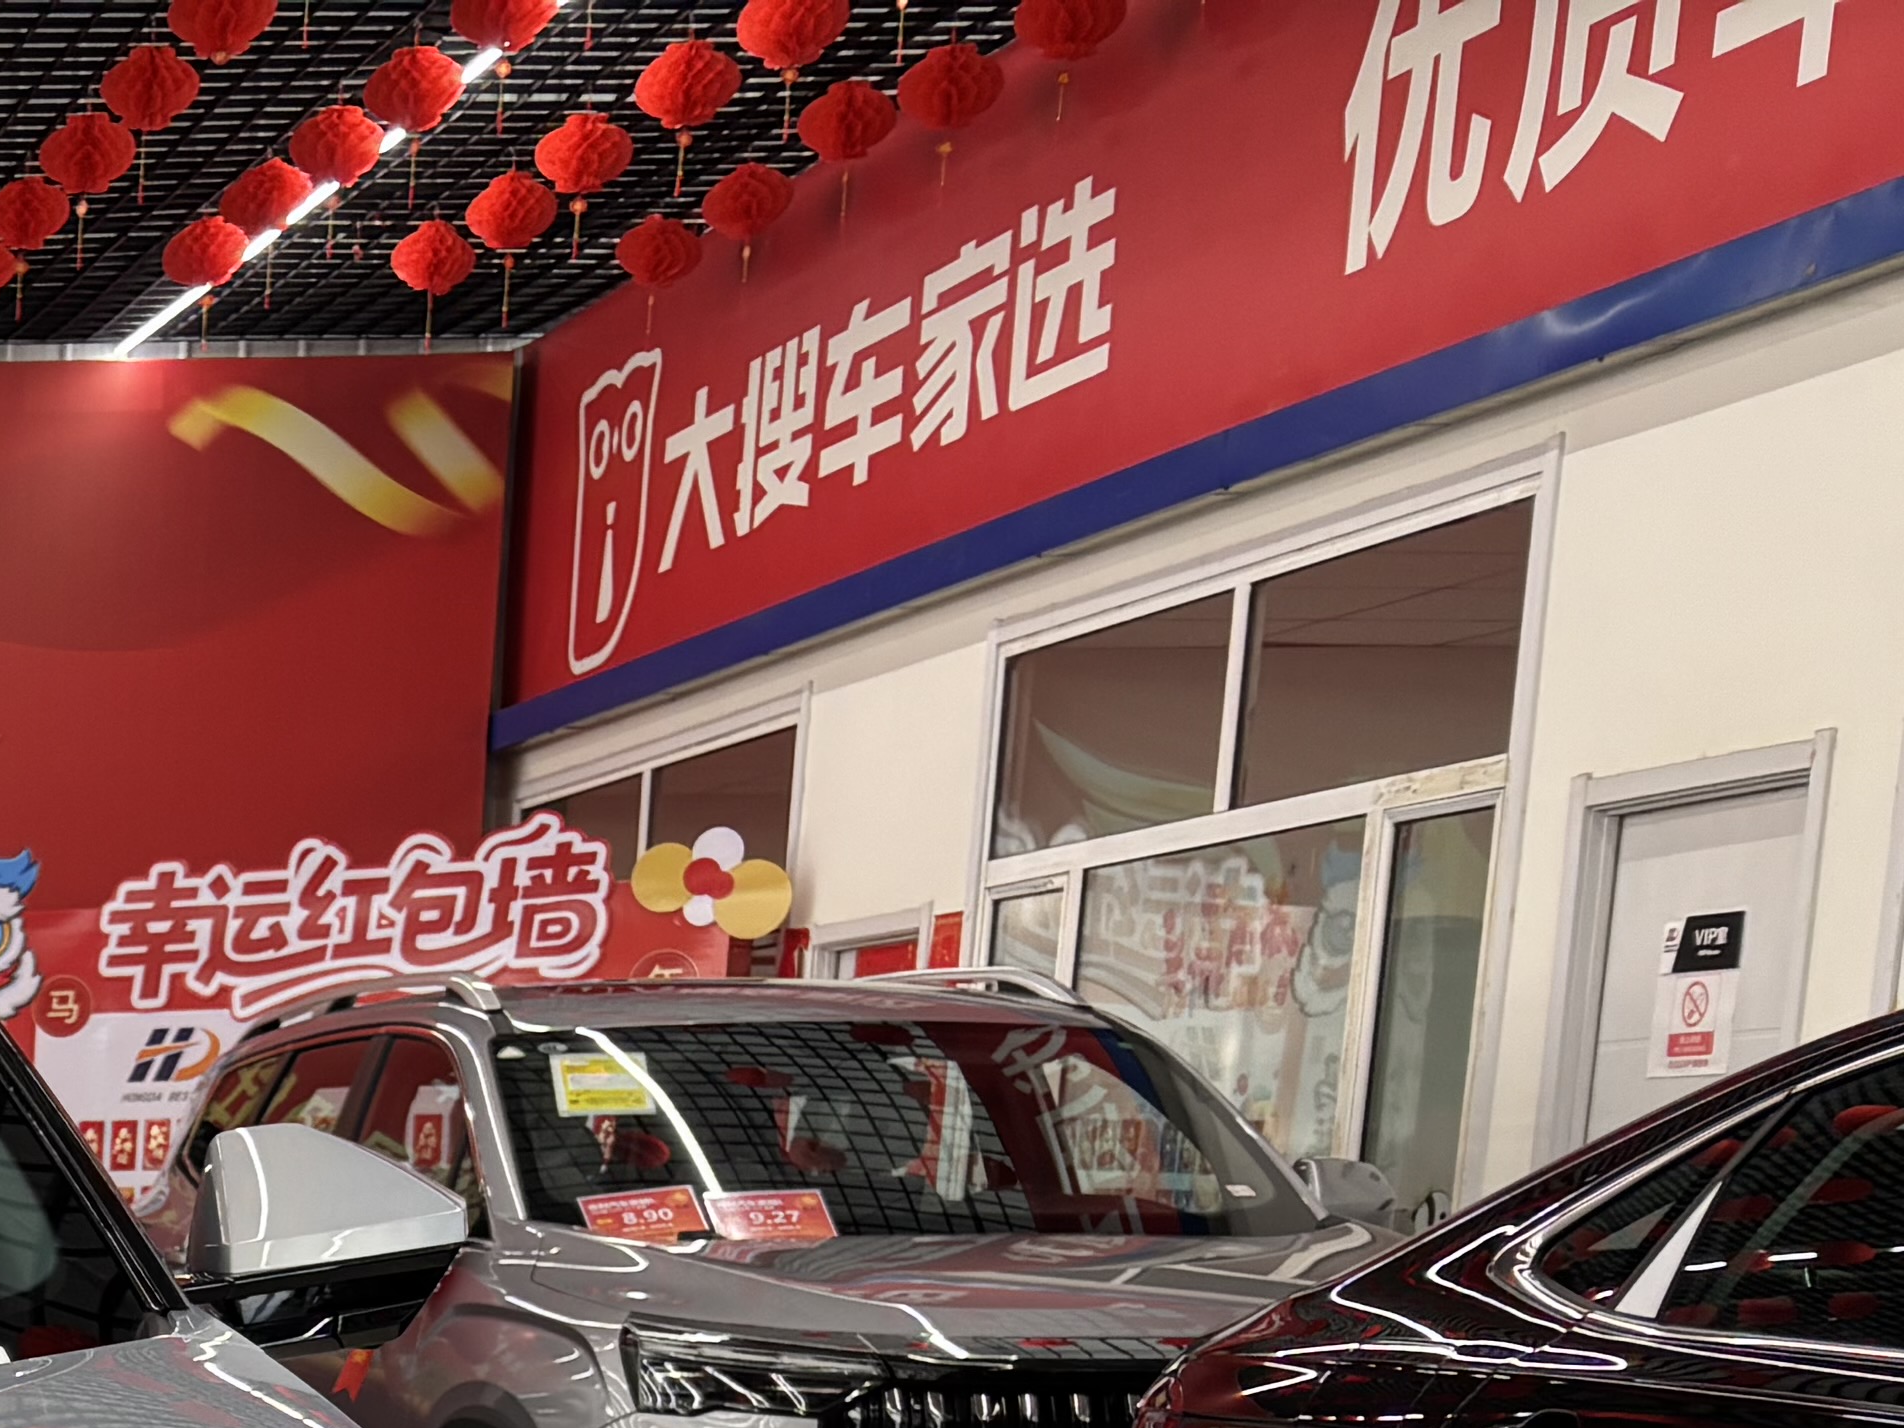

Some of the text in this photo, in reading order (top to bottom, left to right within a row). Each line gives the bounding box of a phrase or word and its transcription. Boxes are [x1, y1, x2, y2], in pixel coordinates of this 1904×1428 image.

[657, 174, 1118, 574] 大搜车家选
[102, 812, 608, 1010] 幸运红包墙
[47, 989, 80, 1025] 马
[622, 1207, 674, 1226] 8.90
[748, 1209, 801, 1226] 9.27
